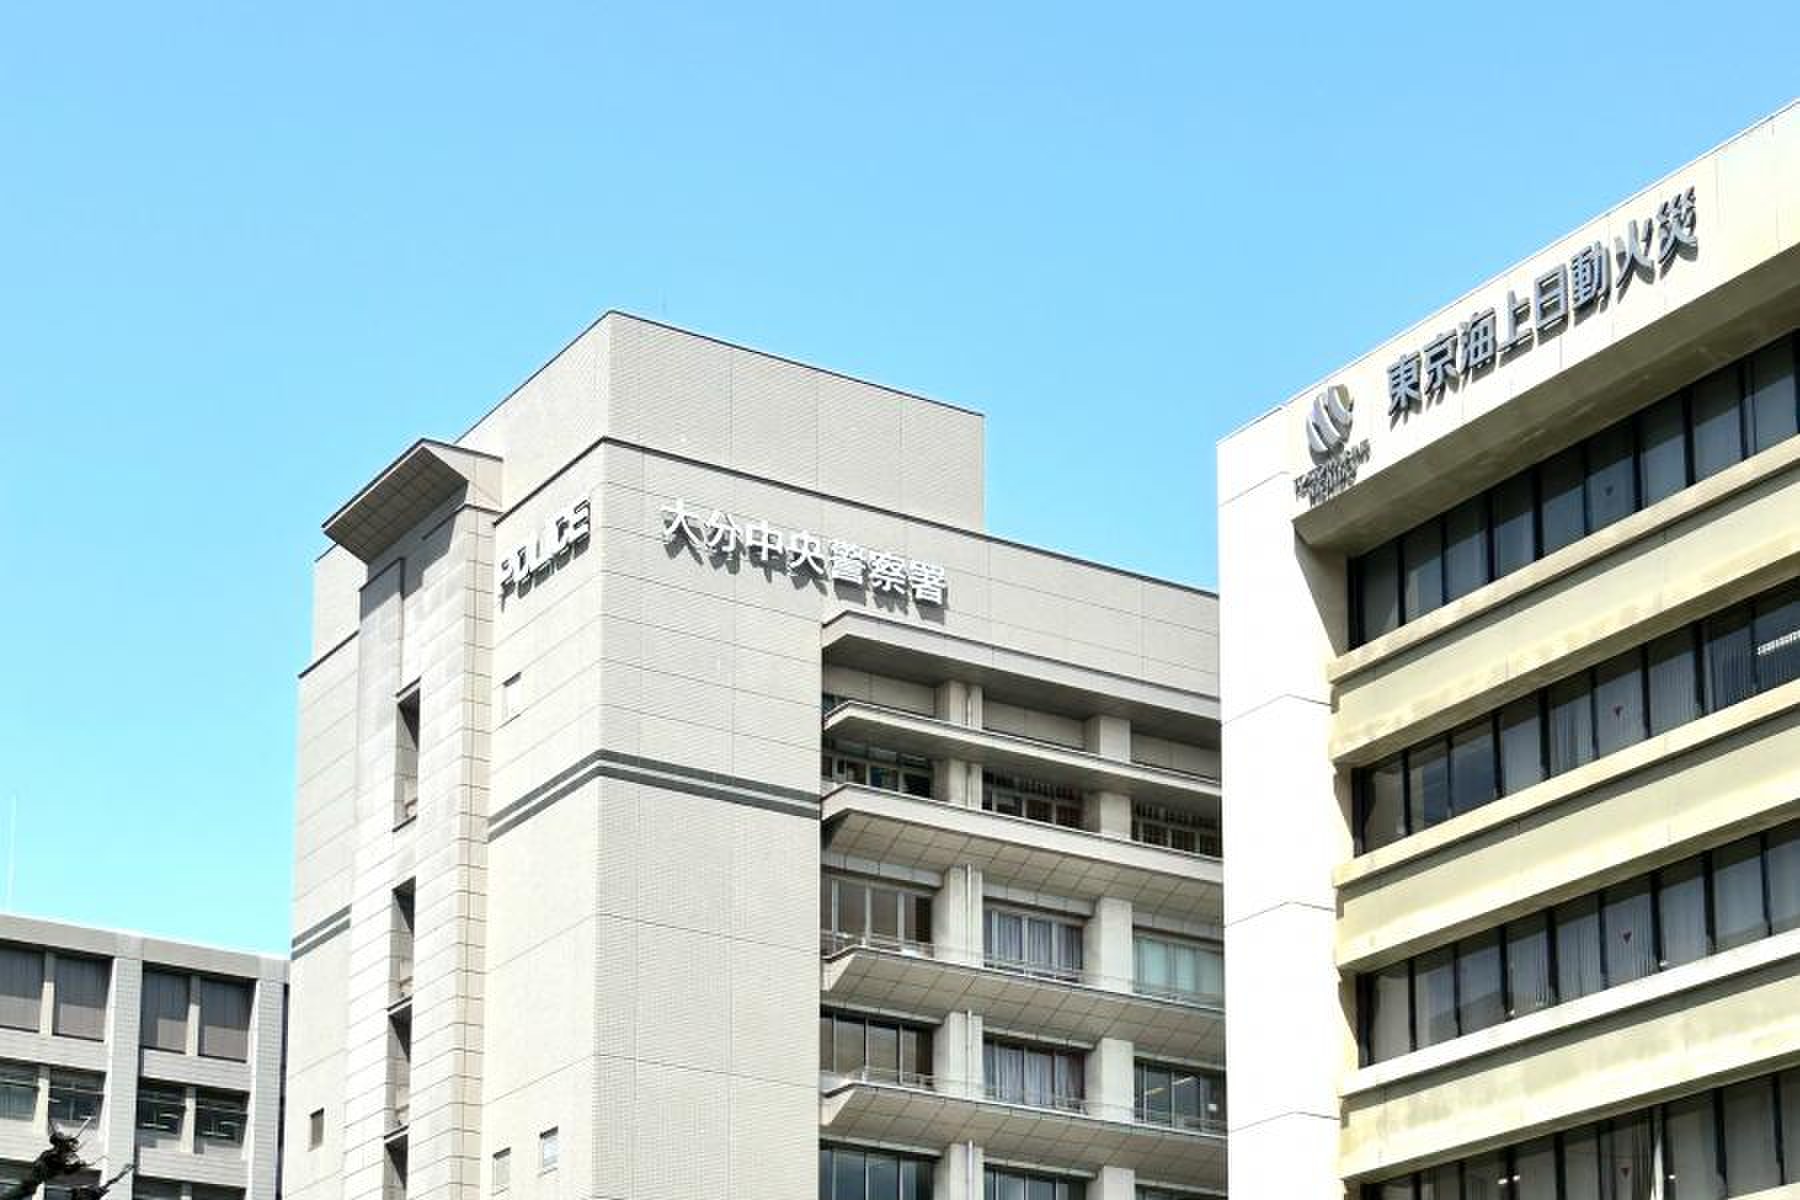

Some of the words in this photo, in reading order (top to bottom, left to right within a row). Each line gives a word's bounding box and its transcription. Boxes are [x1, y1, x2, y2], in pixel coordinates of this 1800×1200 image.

[1387, 185, 1698, 416] 東京海上日動火災
[497, 497, 591, 587] POLICE
[661, 500, 946, 605] 大分中央警察署
